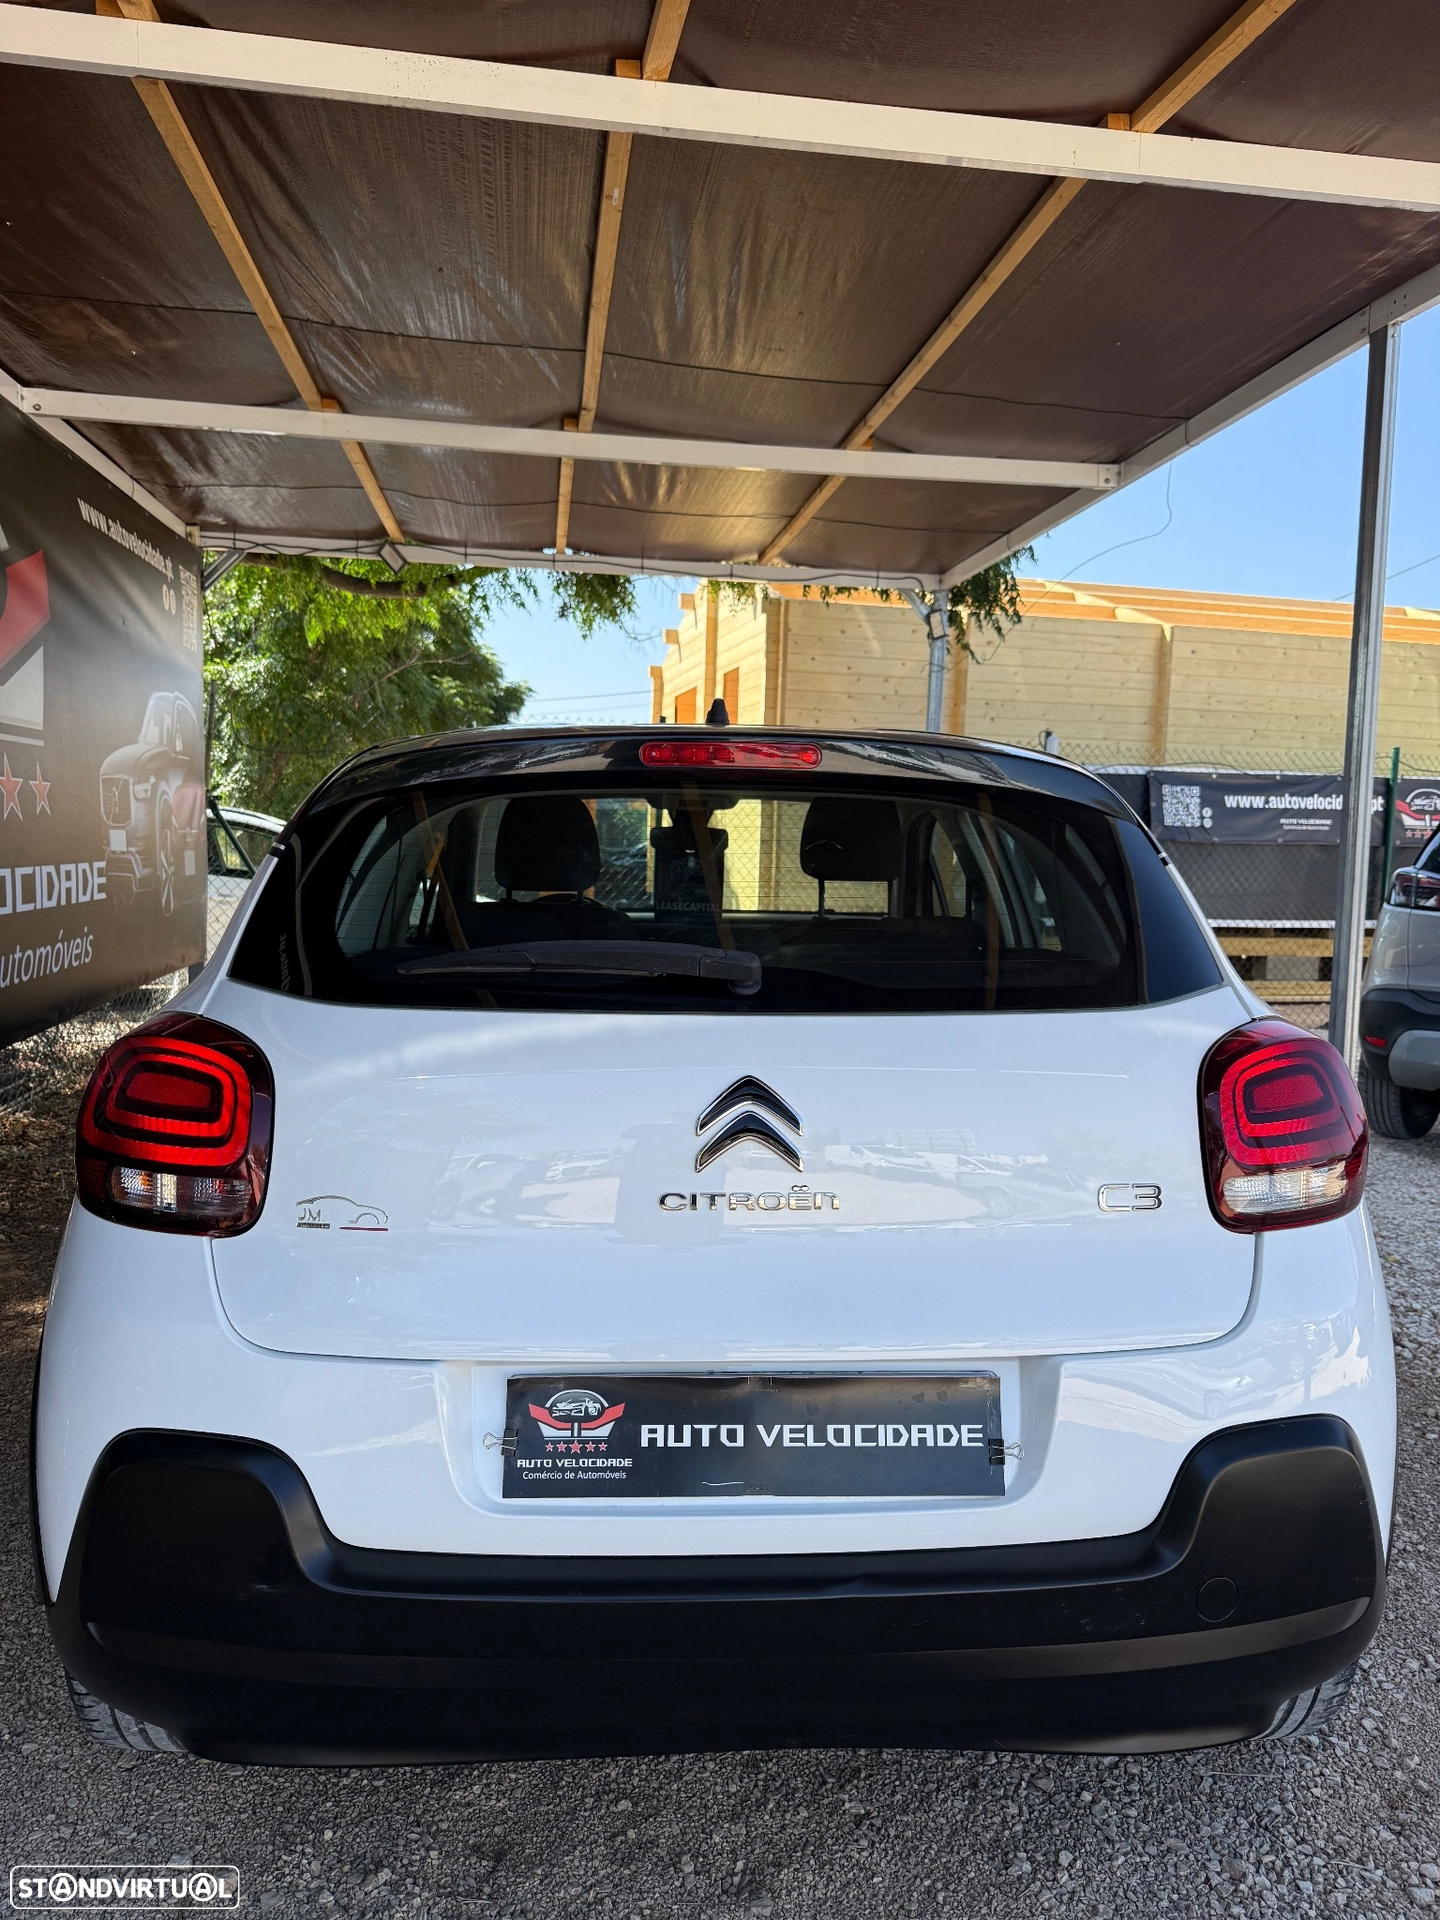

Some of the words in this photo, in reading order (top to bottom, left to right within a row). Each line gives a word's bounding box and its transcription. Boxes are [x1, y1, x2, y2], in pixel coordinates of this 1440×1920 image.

[1097, 1182, 1163, 1212] C3
[640, 1423, 745, 1448] AUTO
[756, 1423, 984, 1448] VELOCIDADE
[516, 1458, 553, 1468] AUTO
[556, 1458, 633, 1468] VELOCIDADE
[522, 1470, 563, 1480] Comércio
[564, 1470, 576, 1480] de
[576, 1470, 627, 1480] Automóveis
